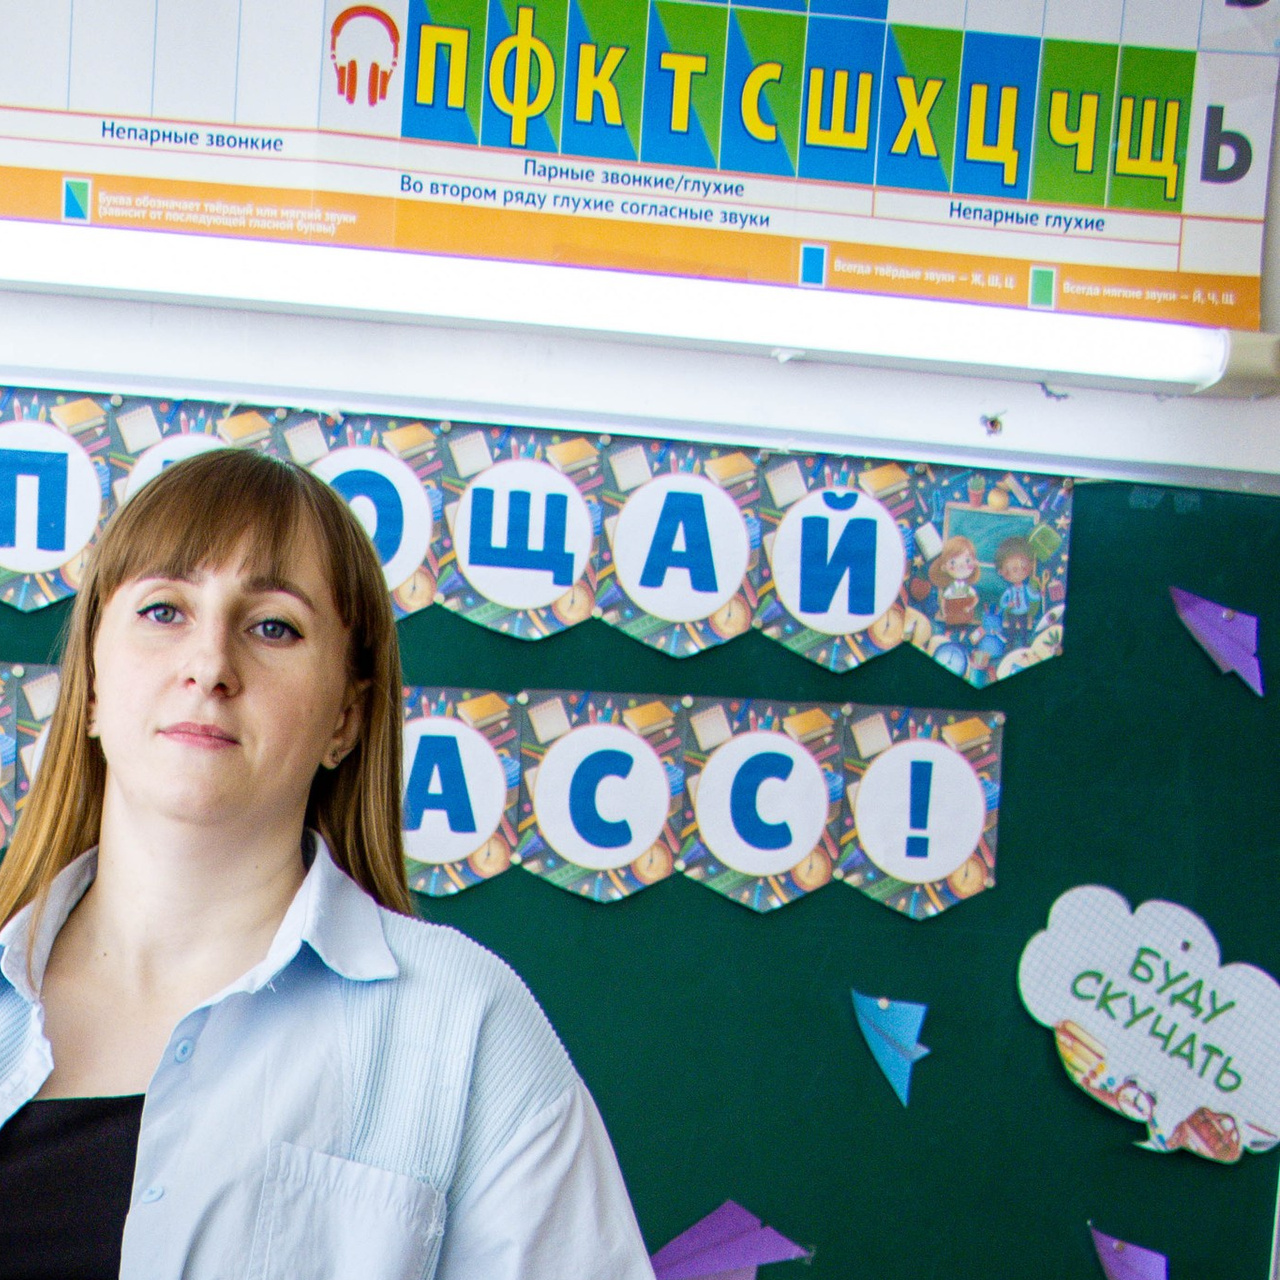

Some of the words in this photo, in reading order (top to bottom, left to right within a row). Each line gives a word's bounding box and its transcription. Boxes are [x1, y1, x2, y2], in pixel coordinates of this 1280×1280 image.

[101, 121, 199, 145] Непарные
[206, 135, 284, 151] звонкие
[523, 159, 595, 183] Парные
[601, 172, 745, 198] звонкие/глухие
[98, 192, 133, 206] Буква
[135, 195, 201, 212] обозначает
[400, 175, 423, 194] Во
[430, 183, 497, 203] втором
[503, 190, 545, 209] ряду
[553, 196, 614, 215] глухие
[621, 203, 714, 223] согласные
[720, 211, 770, 230] звуки
[949, 202, 1039, 229] Непарные
[1045, 213, 1105, 234] глухие
[1129, 947, 1236, 1024] БУДУ
[1071, 971, 1242, 1092] СКУЧАТЬ
